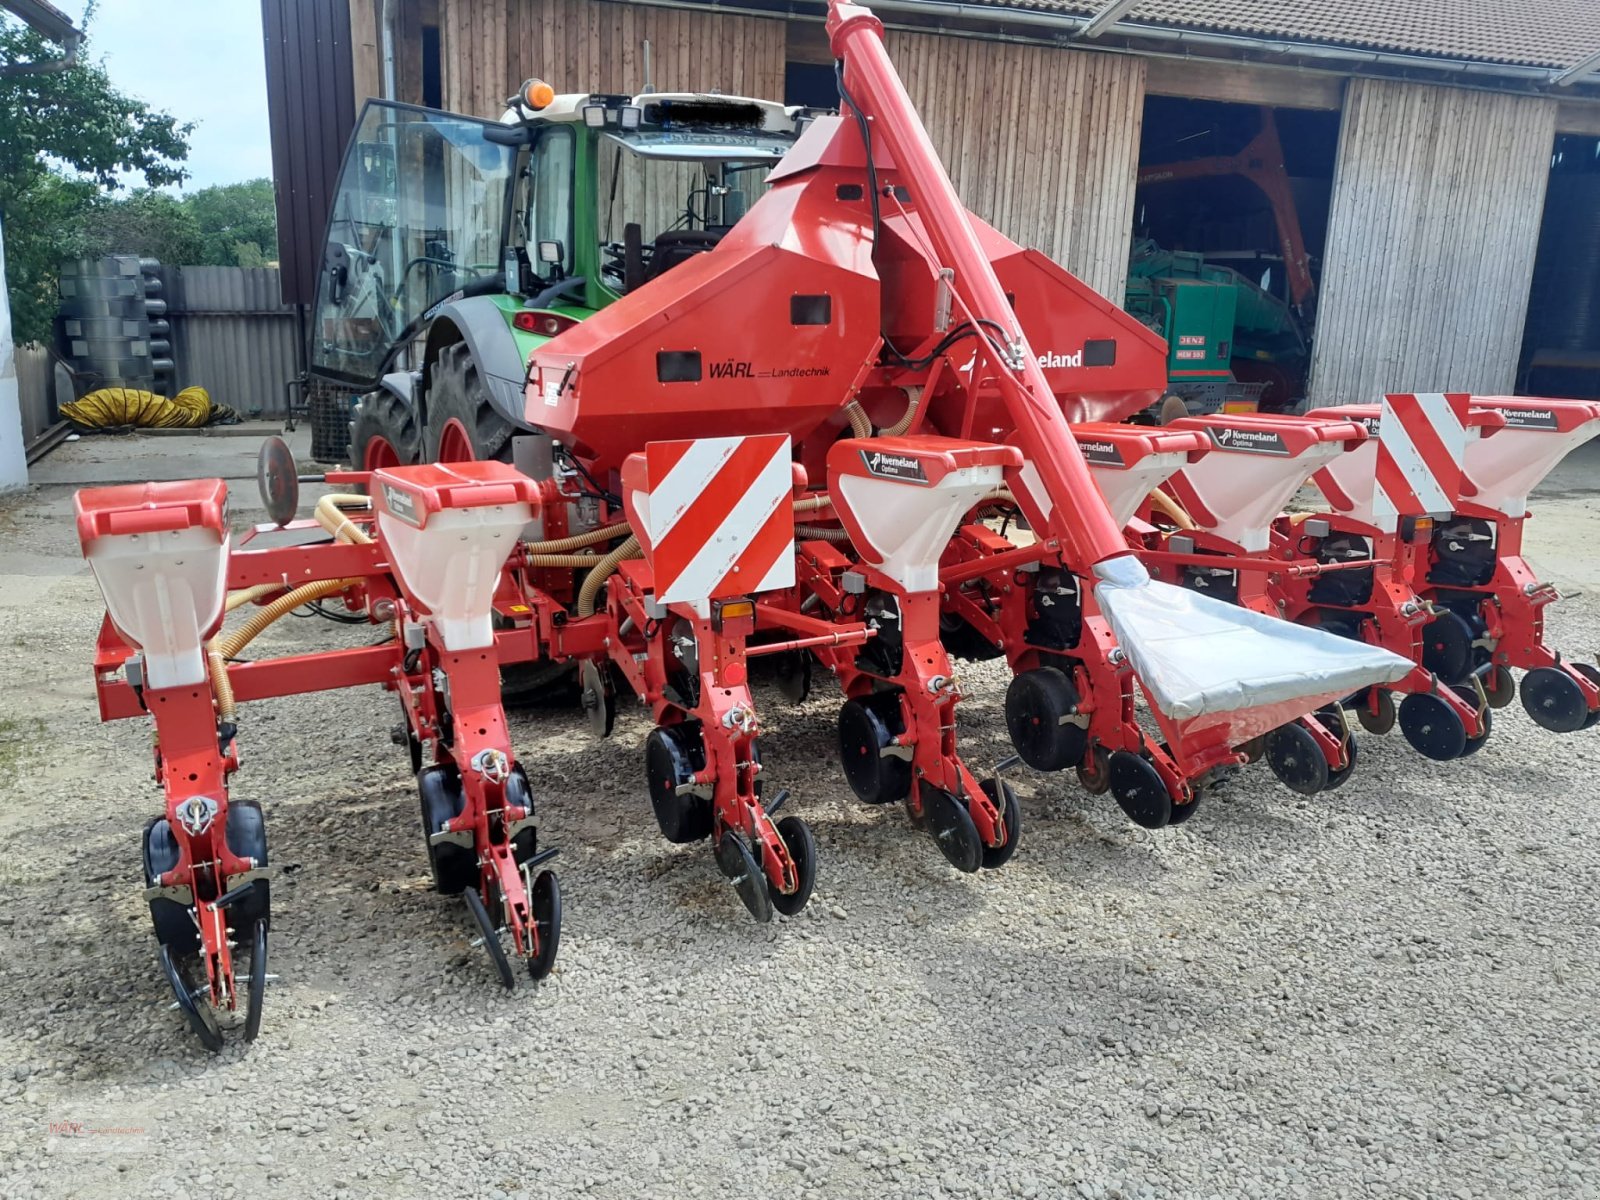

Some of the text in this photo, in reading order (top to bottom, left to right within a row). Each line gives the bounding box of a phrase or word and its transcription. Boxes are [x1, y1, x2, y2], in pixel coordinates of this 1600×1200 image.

[1038, 350, 1082, 368] eland
[709, 358, 830, 378] WÄRL Landtechnik
[1503, 409, 1551, 419] Kverneland
[1232, 430, 1277, 442] Kverneland
[881, 455, 918, 469] Kverneland
[881, 465, 898, 474] Optima
